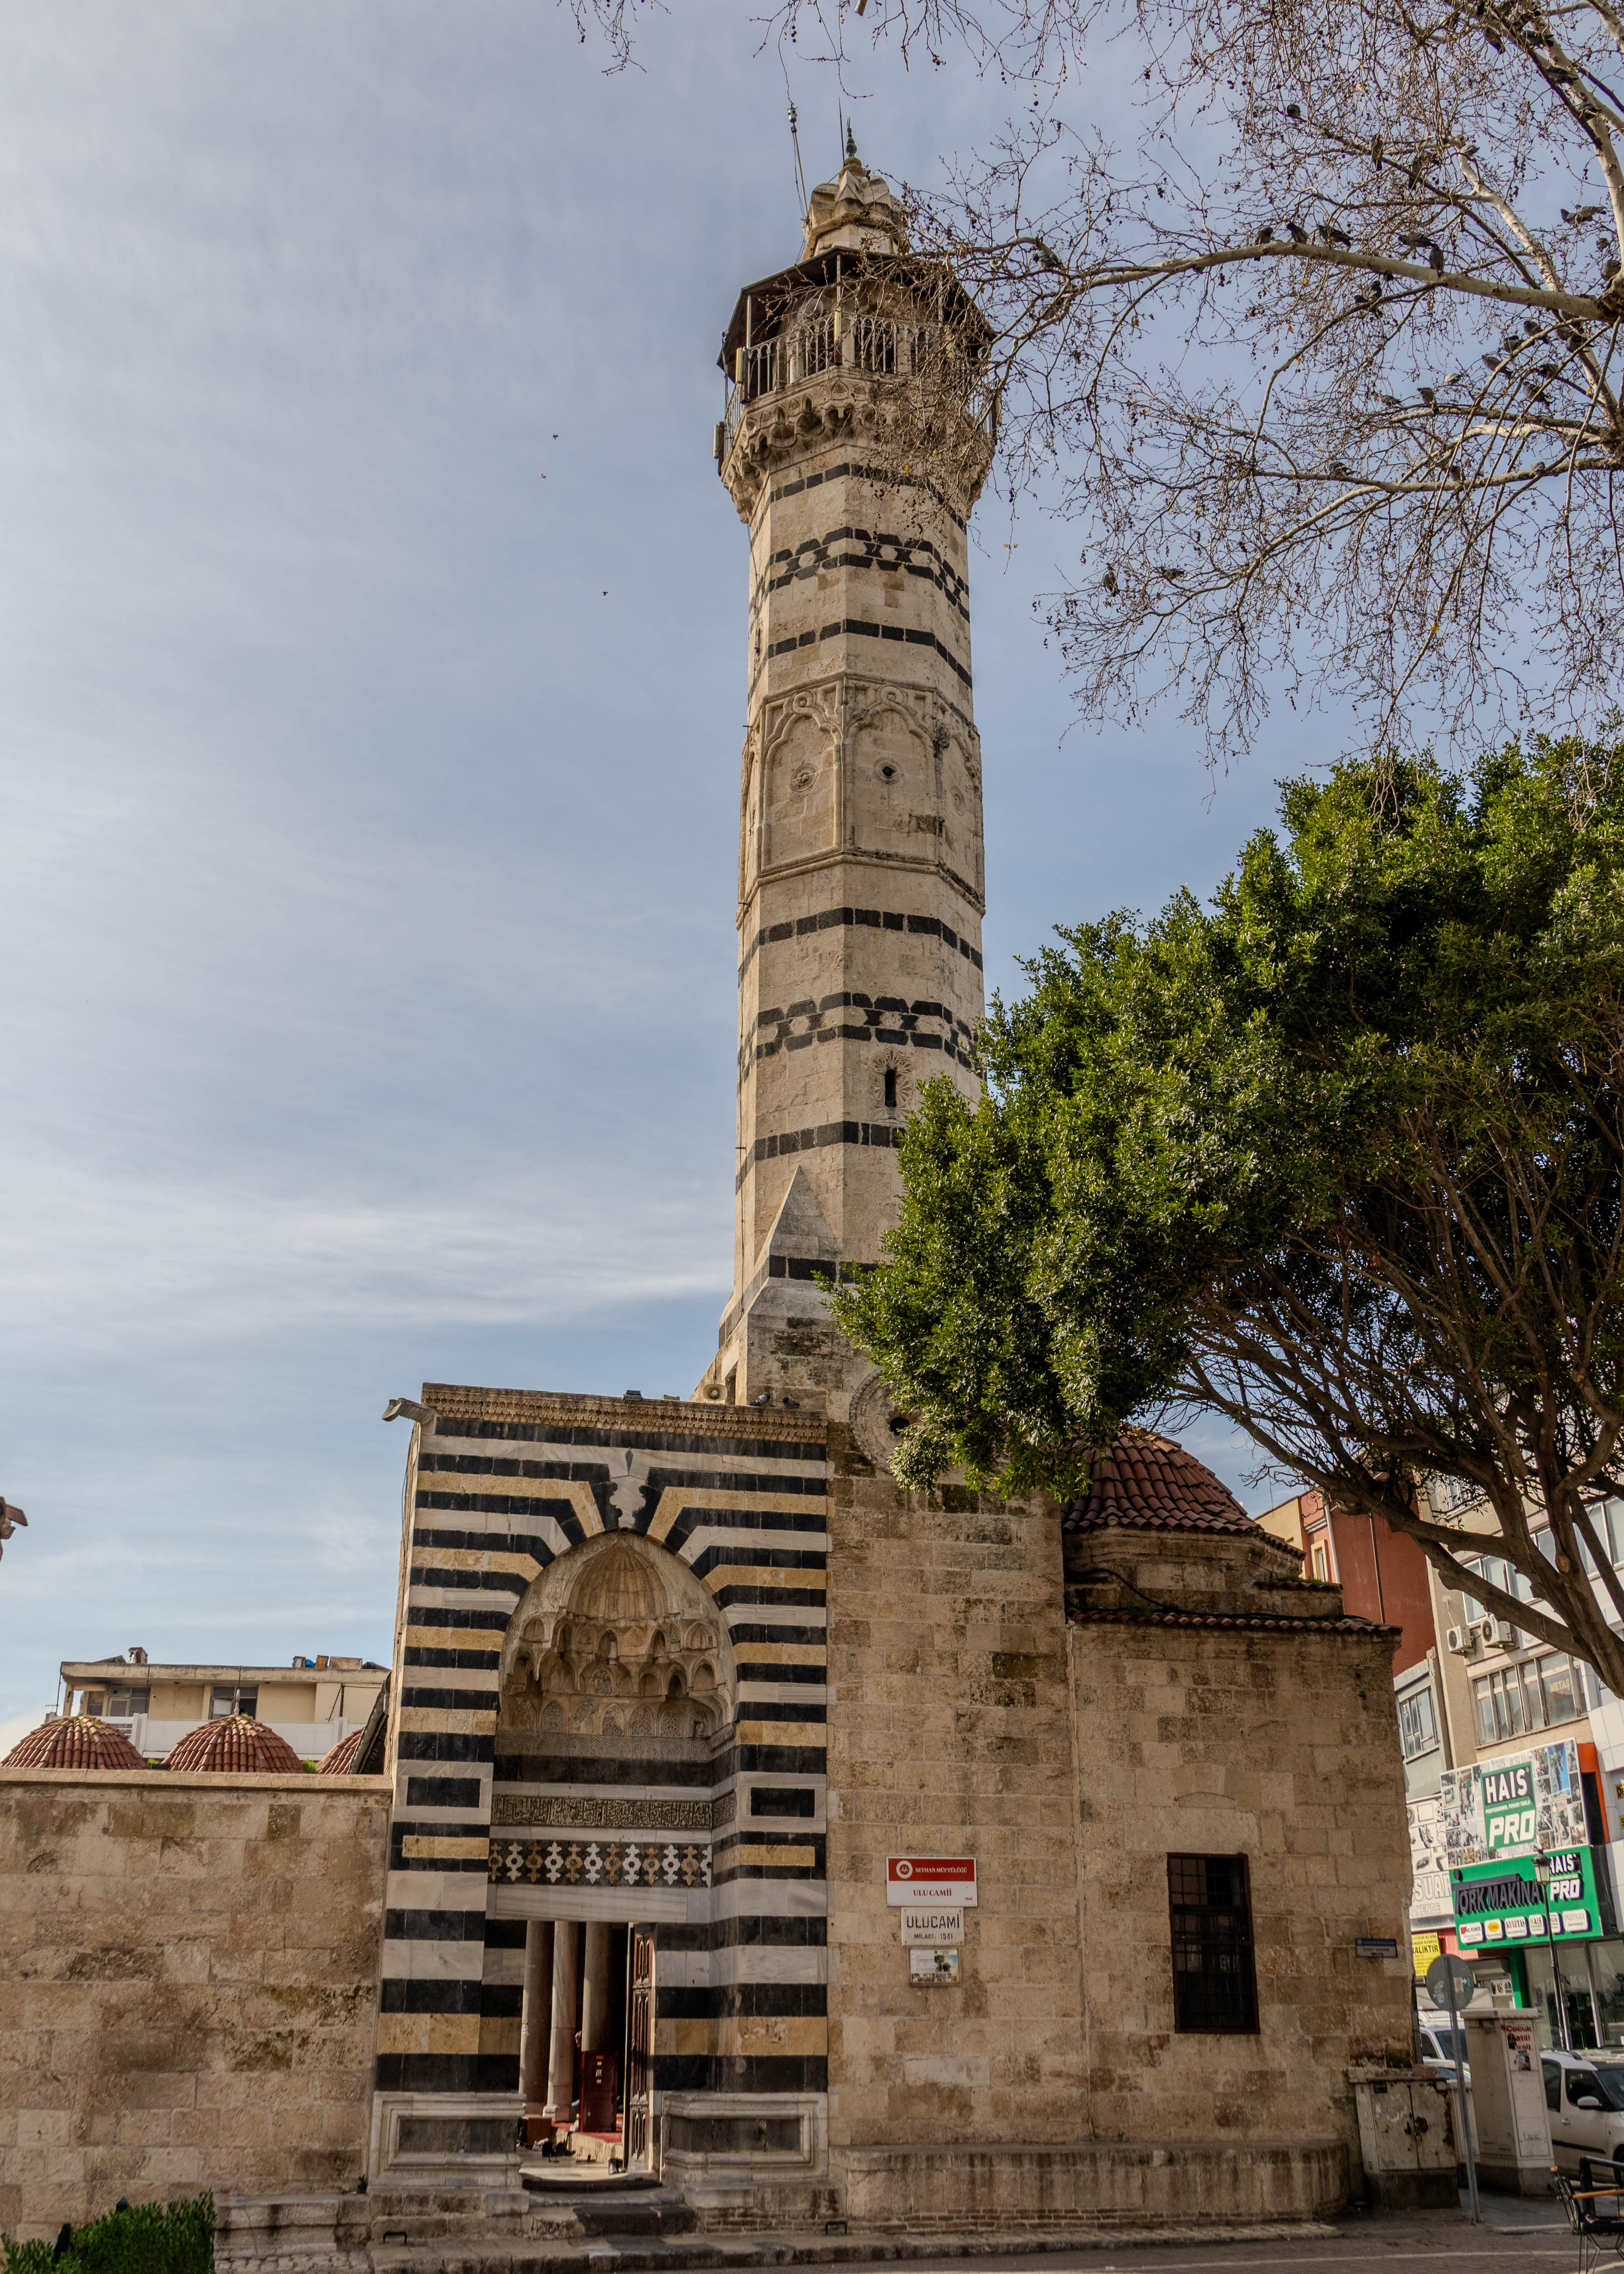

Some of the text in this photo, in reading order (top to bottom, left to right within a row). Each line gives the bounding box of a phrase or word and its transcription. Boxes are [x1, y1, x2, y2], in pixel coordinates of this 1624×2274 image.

[1485, 1768, 1528, 1804] HAIS
[1489, 1809, 1536, 1847] PRO
[929, 1888, 952, 1896] CAMİİ
[1414, 1873, 1451, 1902] SUAR
[1550, 1878, 1580, 1901] PRO
